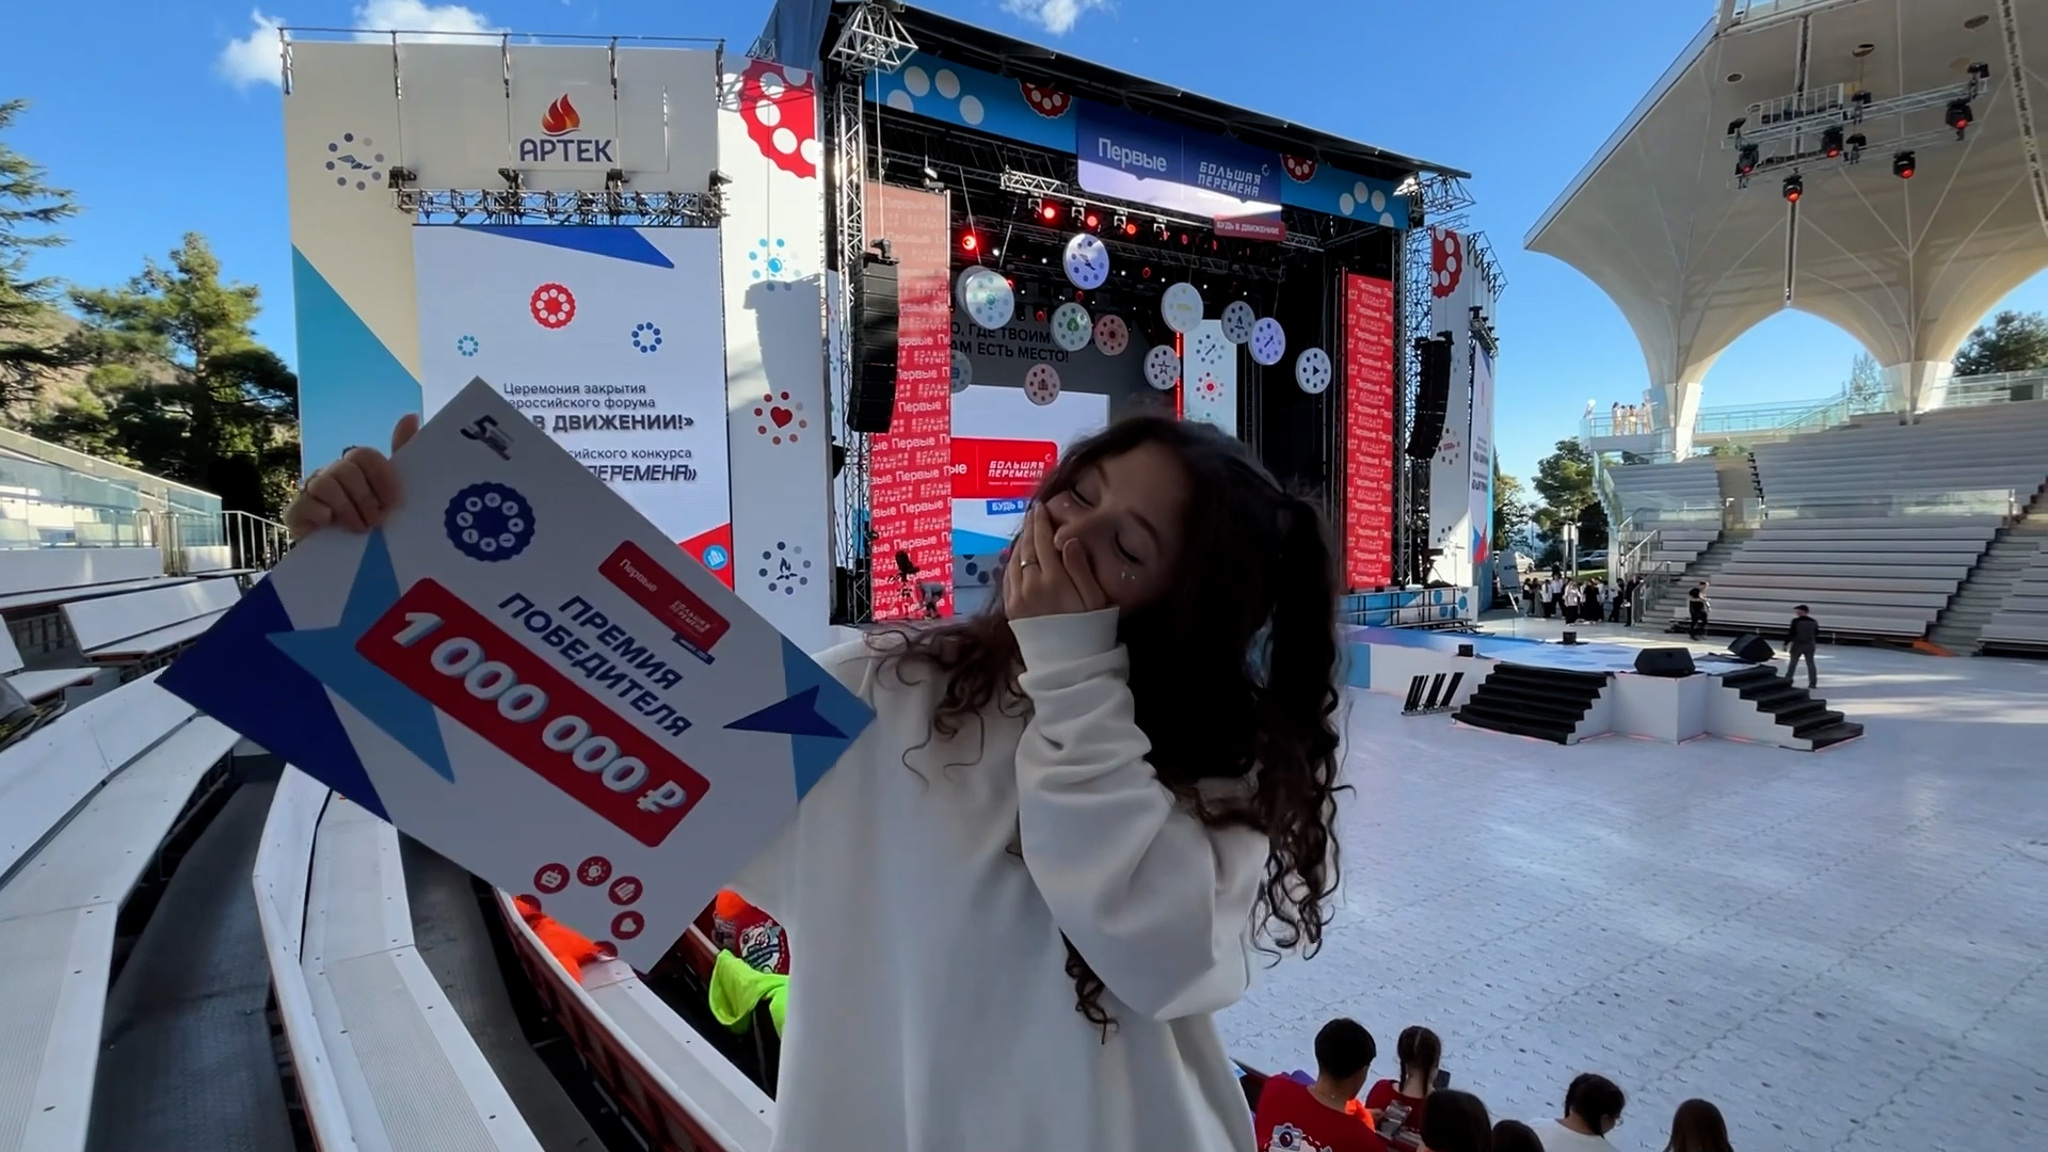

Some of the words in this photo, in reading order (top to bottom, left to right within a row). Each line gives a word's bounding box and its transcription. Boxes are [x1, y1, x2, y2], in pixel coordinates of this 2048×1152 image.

[519, 138, 614, 162] АРТЕК
[1098, 137, 1168, 172] Первые
[1199, 160, 1262, 186] БОЛЬШАЯ
[1198, 173, 1260, 197] ПЕРЕМЕНА
[950, 321, 964, 336] О,
[969, 322, 997, 339] ГДЕ
[899, 337, 934, 349] ервые
[950, 340, 972, 354] АМ
[978, 342, 1014, 357] ЕСТЬ
[1018, 347, 1069, 363] МЕСТО!
[503, 382, 580, 397] Церемония
[584, 384, 646, 395] закрытия
[510, 397, 600, 410] ероссийского
[604, 397, 656, 410] форума
[898, 401, 942, 415] Первые
[552, 414, 694, 433] ДВИЖЕНИИ!»
[892, 436, 935, 451] Первые
[569, 448, 627, 460] ийского
[631, 449, 692, 461] конкурса
[989, 460, 1045, 469] БОЛЬШАЯ
[896, 469, 939, 484] Первые
[900, 500, 944, 515] Первые
[991, 501, 1016, 512] БУДЬ
[894, 536, 937, 551] Первые
[558, 595, 683, 690] ПРЕМИЯ
[498, 592, 693, 737] ПОБЕДИТЕЛЯ
[392, 612, 444, 647] 1
[430, 637, 549, 722] 000
[542, 715, 649, 793] 000
